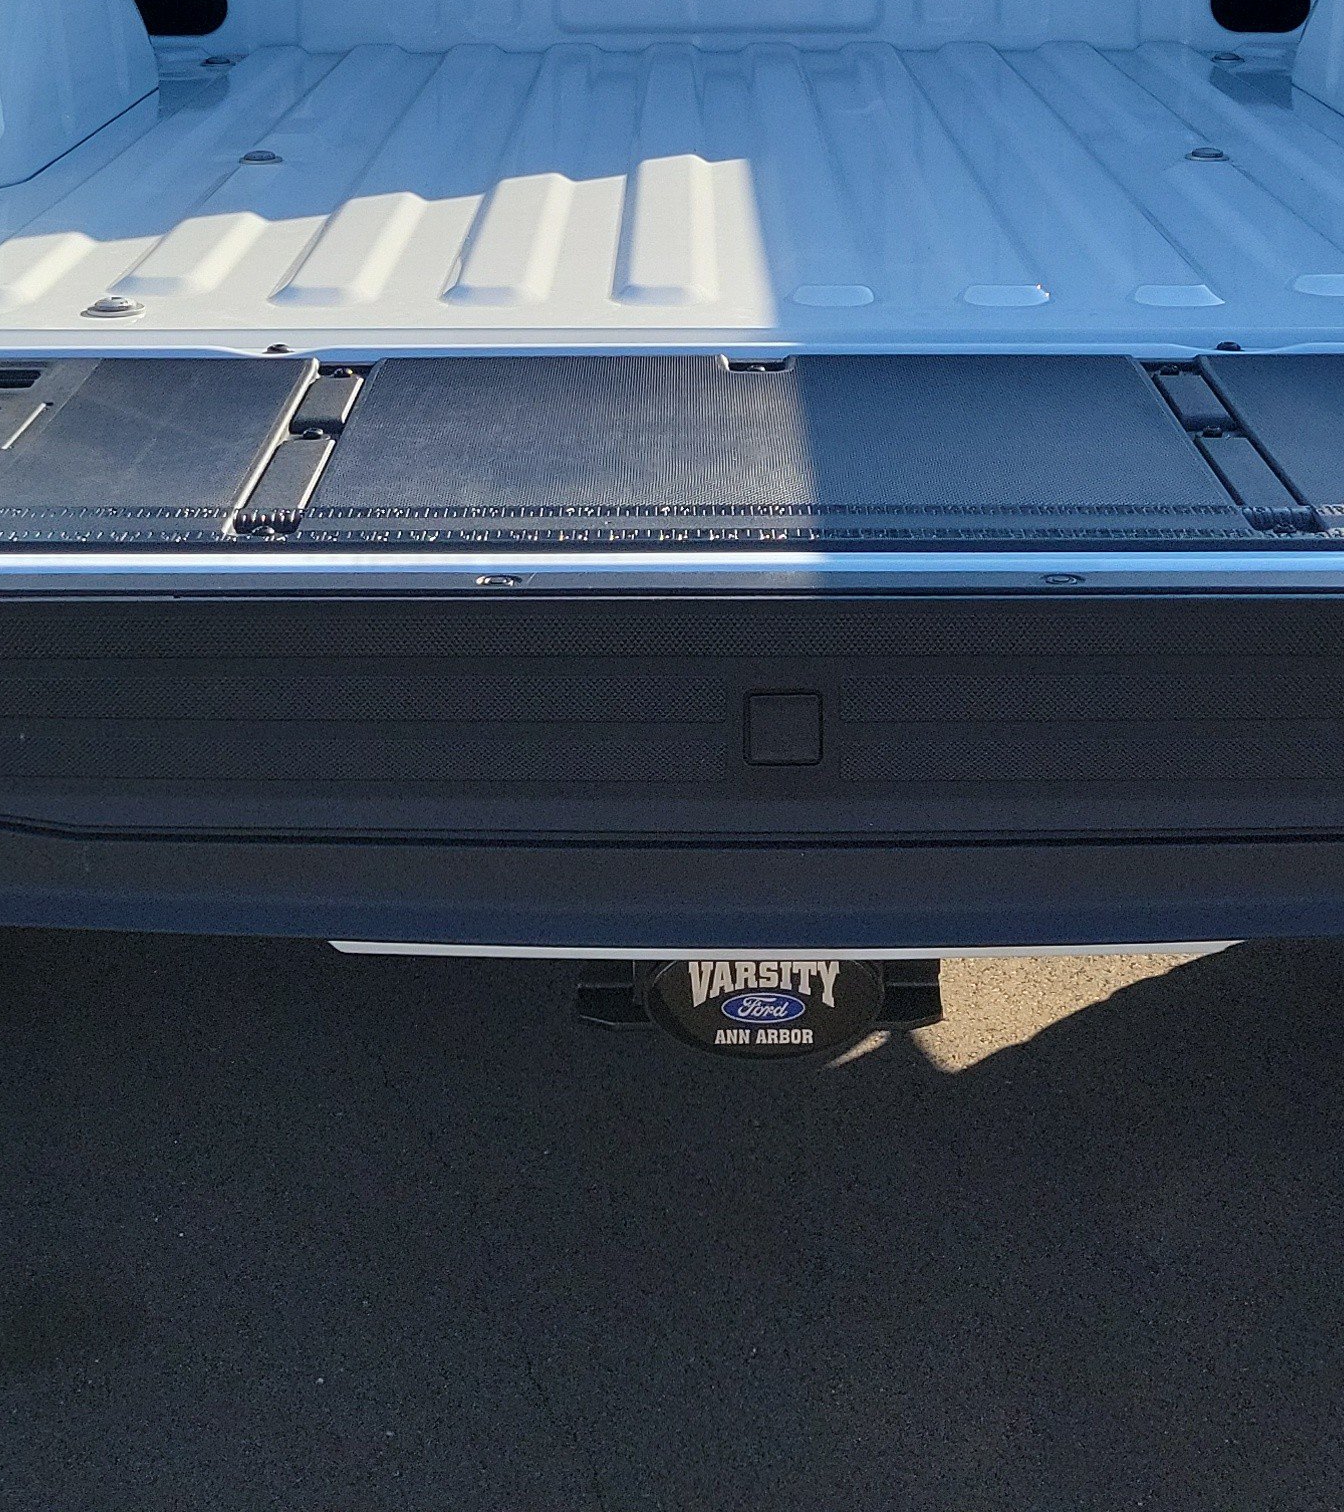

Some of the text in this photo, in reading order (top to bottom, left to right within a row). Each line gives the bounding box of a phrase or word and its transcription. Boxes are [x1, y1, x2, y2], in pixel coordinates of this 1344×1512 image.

[688, 961, 839, 1008] VARSITY
[737, 996, 789, 1018] Ford
[714, 1029, 814, 1045] ANN ARBOR
